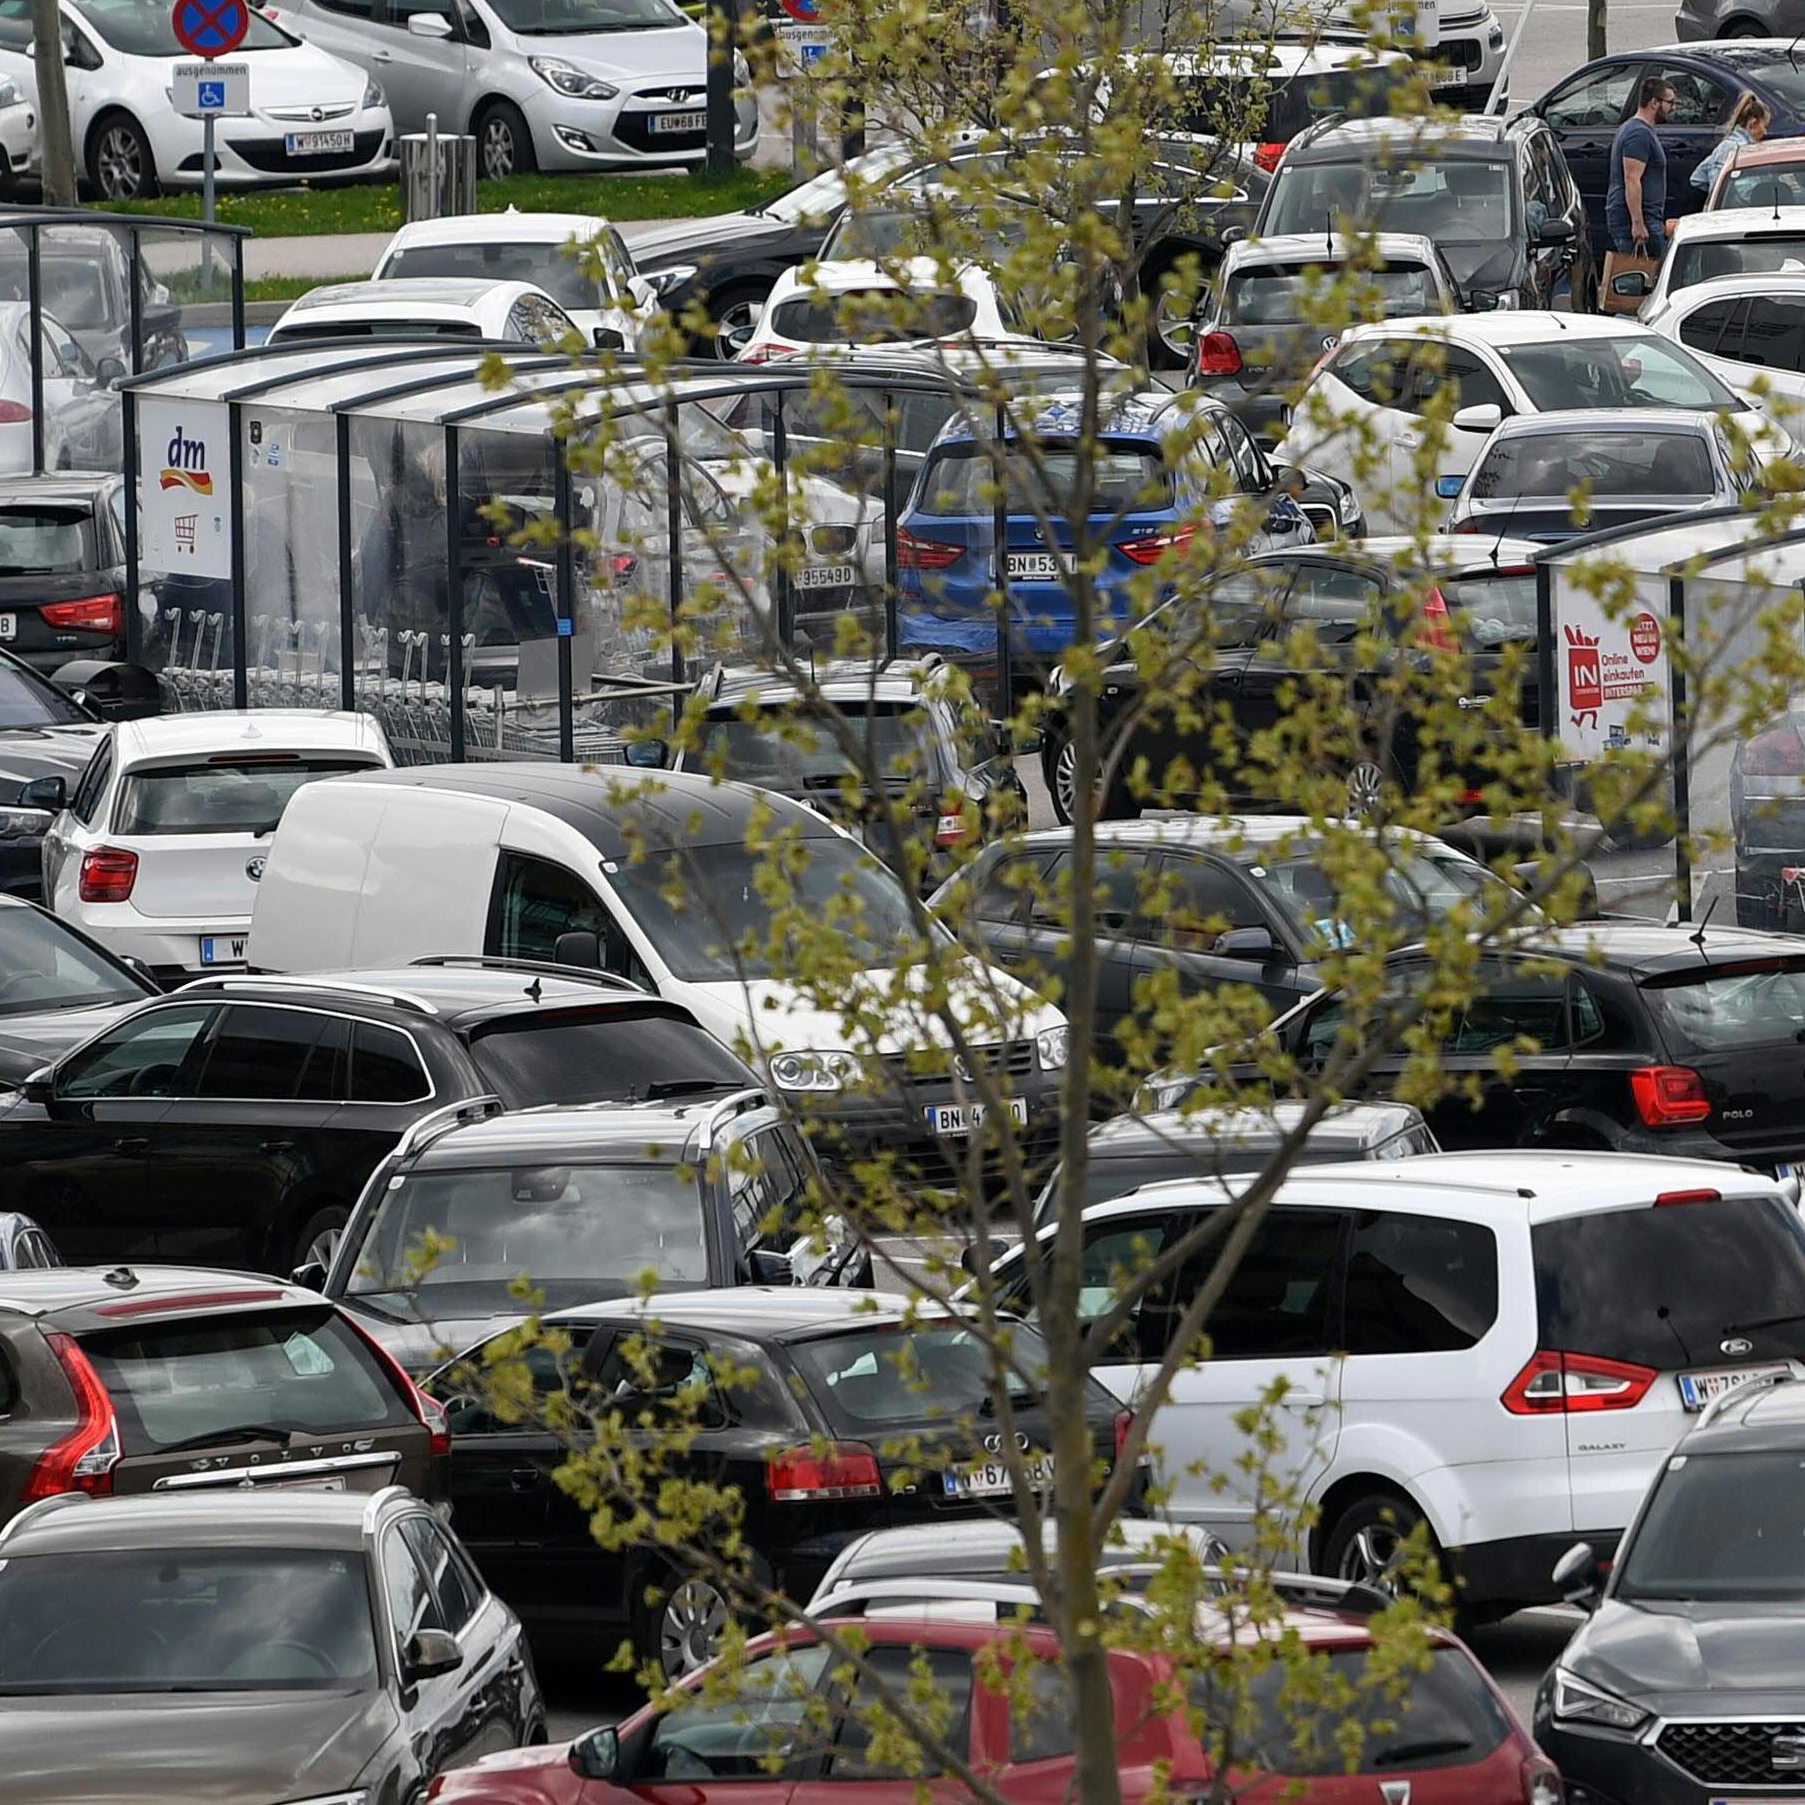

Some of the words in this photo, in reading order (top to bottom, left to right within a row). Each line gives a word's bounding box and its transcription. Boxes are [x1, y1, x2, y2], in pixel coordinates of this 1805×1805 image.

[176, 63, 247, 80] ausgenommen
[168, 426, 206, 470] dm
[1602, 652, 1628, 666] Online
[1575, 666, 1599, 688] IN
[1603, 668, 1645, 683] einkaufen
[1722, 1109, 1755, 1121] POLO
[1695, 1377, 1710, 1400] W
[1578, 1442, 1628, 1451] GALAXY
